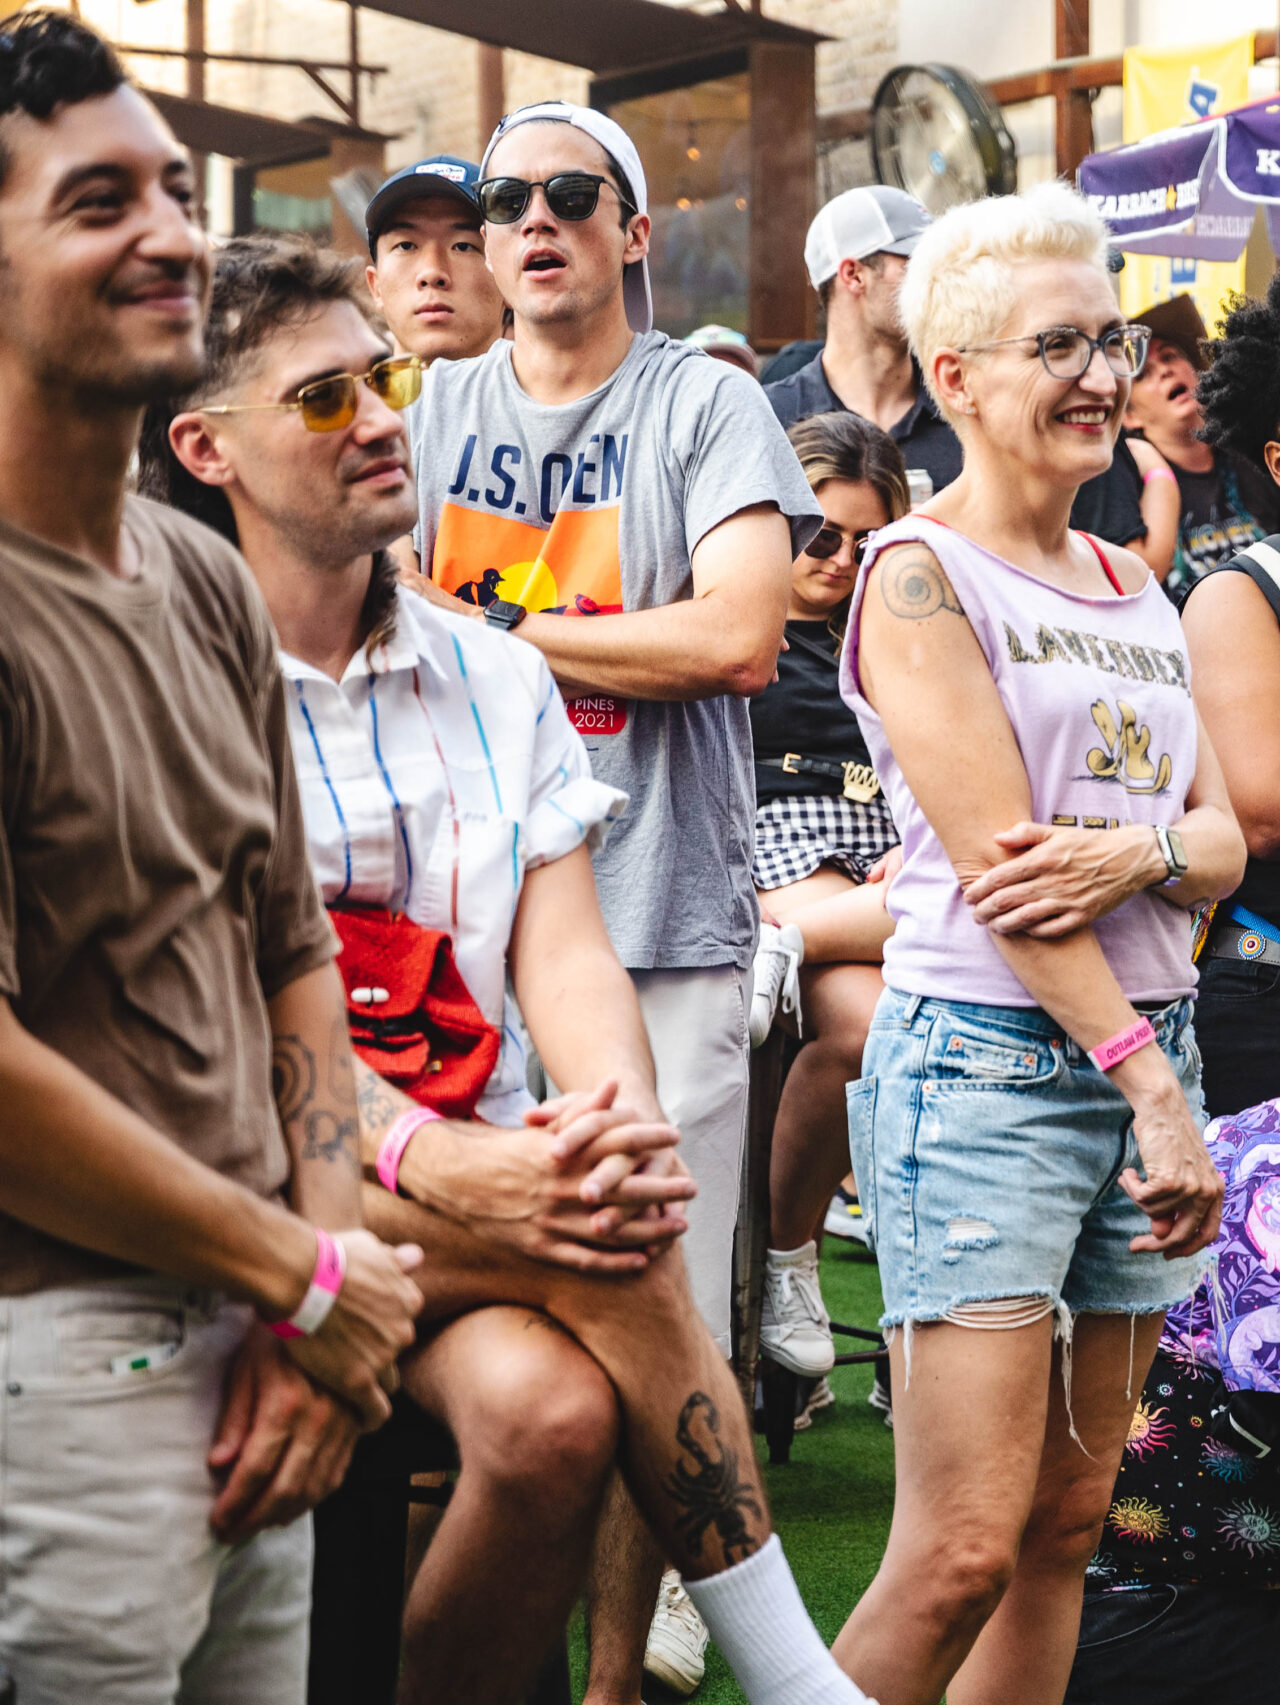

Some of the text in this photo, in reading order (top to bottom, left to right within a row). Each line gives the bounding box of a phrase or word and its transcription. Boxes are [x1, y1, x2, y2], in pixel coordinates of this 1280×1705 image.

[539, 434, 629, 524] OEN
[575, 698, 615, 711] PINES
[575, 712, 614, 728] 2021
